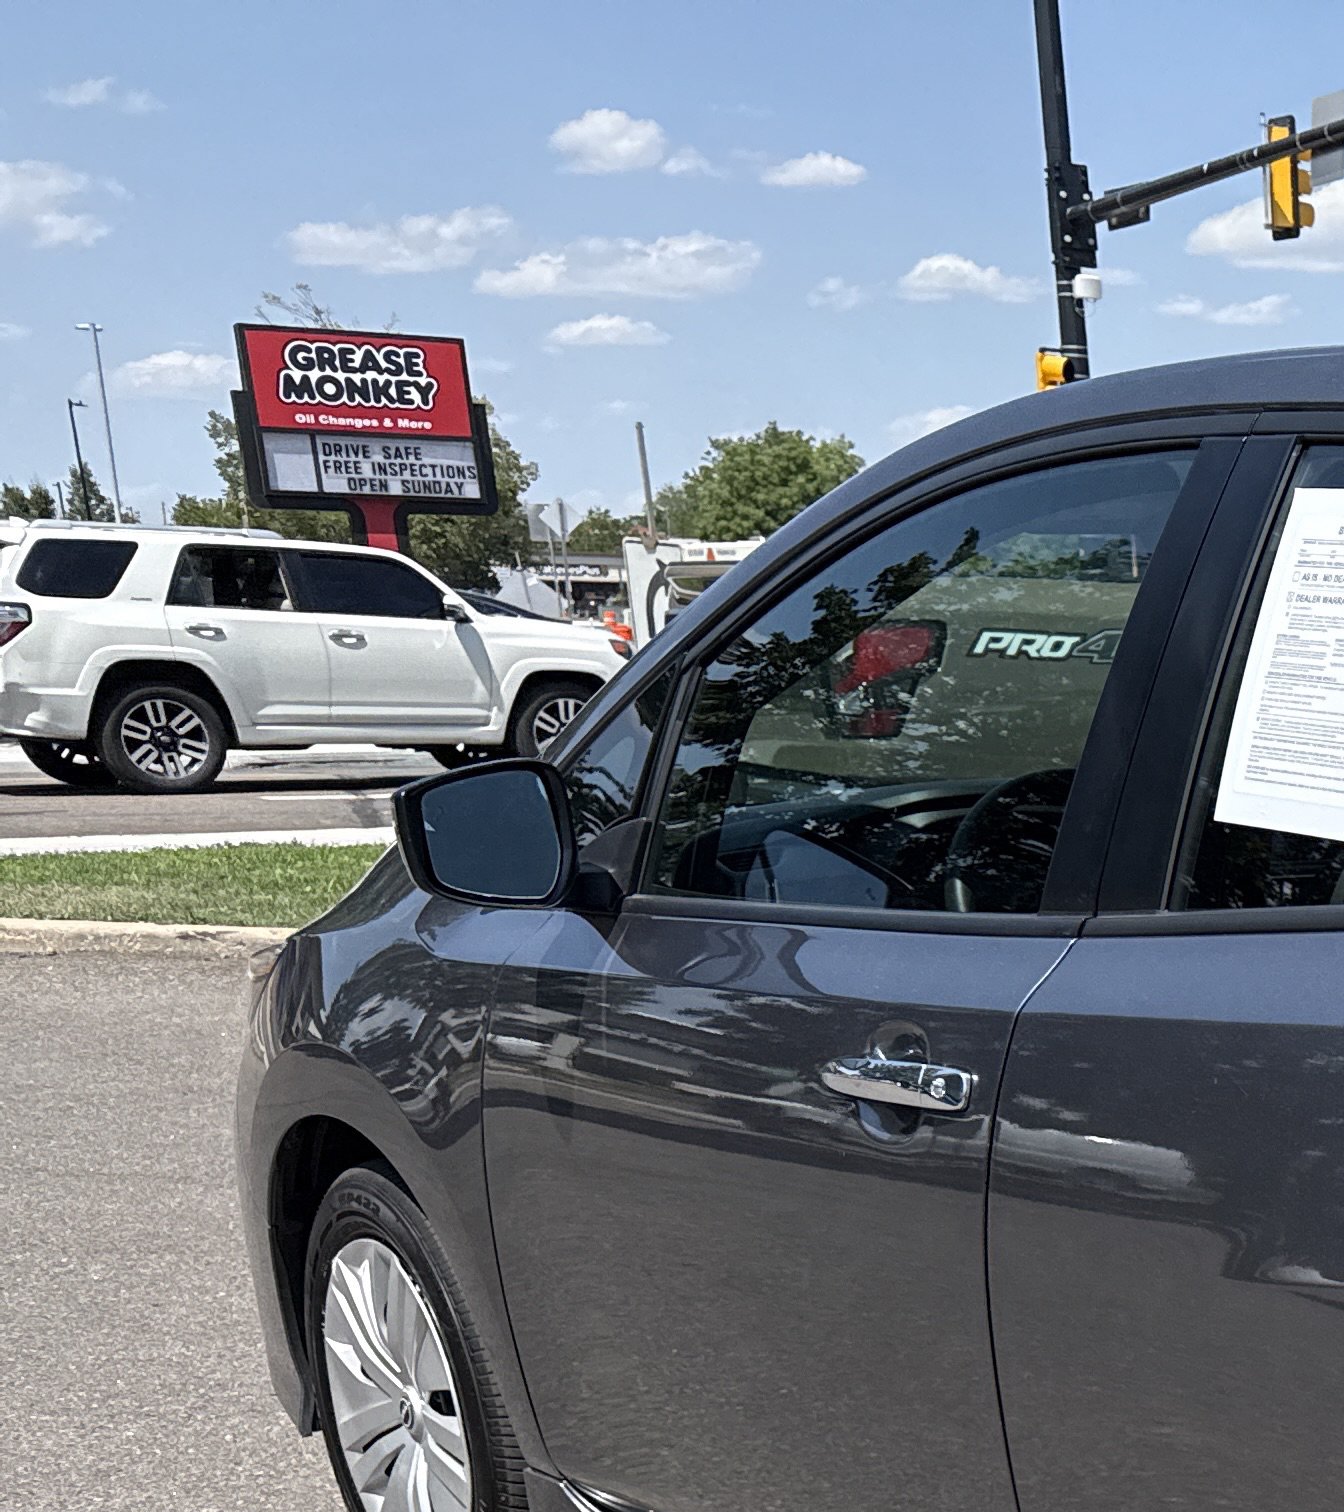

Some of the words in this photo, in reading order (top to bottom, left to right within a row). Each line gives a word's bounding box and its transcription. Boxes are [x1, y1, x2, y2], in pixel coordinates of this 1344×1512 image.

[285, 342, 426, 378] GREASE
[280, 372, 437, 409] MONKEY
[294, 412, 316, 425] Oil
[318, 414, 379, 428] Changes
[383, 416, 394, 428] &
[397, 417, 433, 430] More
[321, 442, 372, 460] DRIVE
[382, 445, 423, 461] SAFE
[323, 460, 363, 475] FREE
[371, 461, 477, 481] INSPECTIONS
[347, 477, 388, 493] OPEN
[401, 479, 465, 496] SUNDAY
